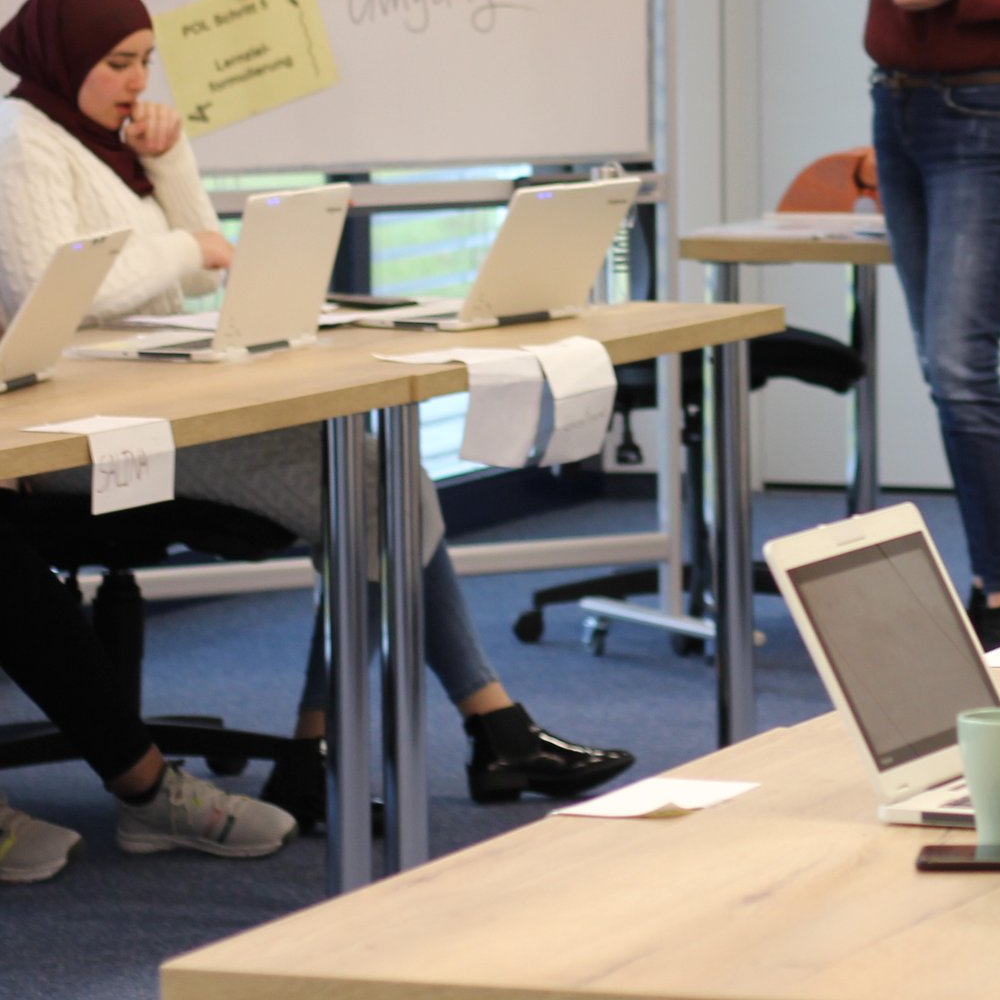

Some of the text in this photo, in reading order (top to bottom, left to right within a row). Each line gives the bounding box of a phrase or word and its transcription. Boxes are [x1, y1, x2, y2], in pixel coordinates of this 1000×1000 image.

[182, 20, 210, 37] POL
[214, 2, 256, 27] Schritt
[208, 55, 294, 94] formulierung
